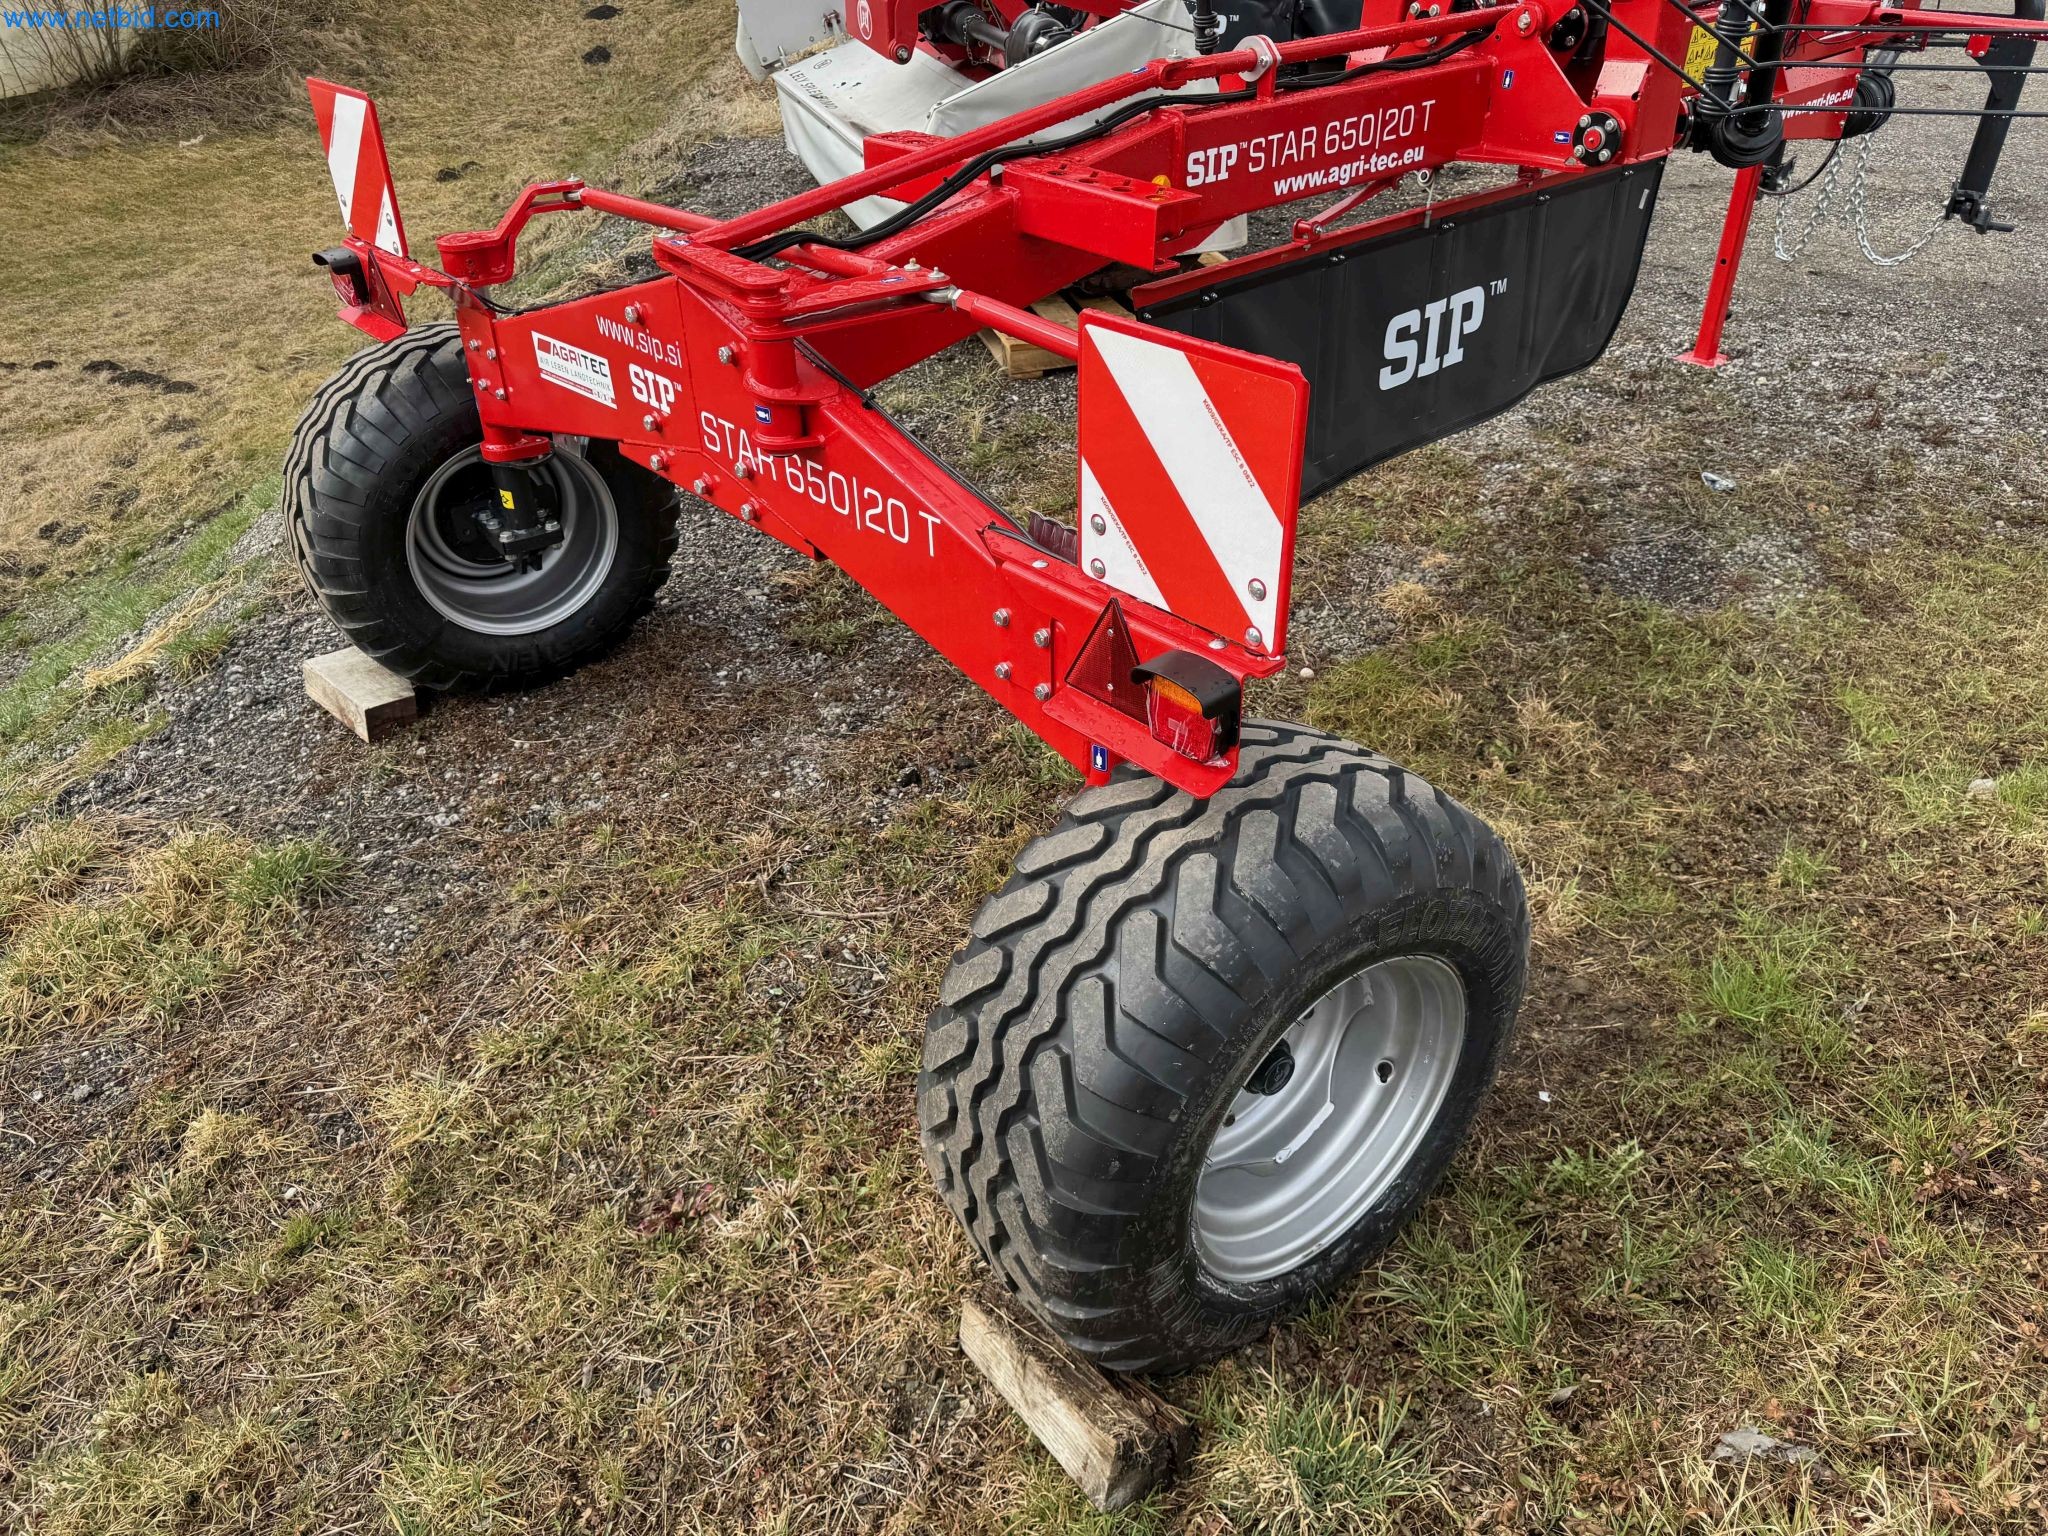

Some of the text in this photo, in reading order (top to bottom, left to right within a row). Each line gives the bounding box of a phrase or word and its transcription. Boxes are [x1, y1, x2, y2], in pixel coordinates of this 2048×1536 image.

[789, 71, 808, 83] LELY
[1249, 126, 1317, 172] STAR
[1422, 100, 1436, 132] T
[1273, 146, 1424, 196] www.agri-tec.eu
[552, 343, 608, 377] AGRITEC
[596, 314, 683, 368] www.sip.si
[919, 510, 941, 557] T
